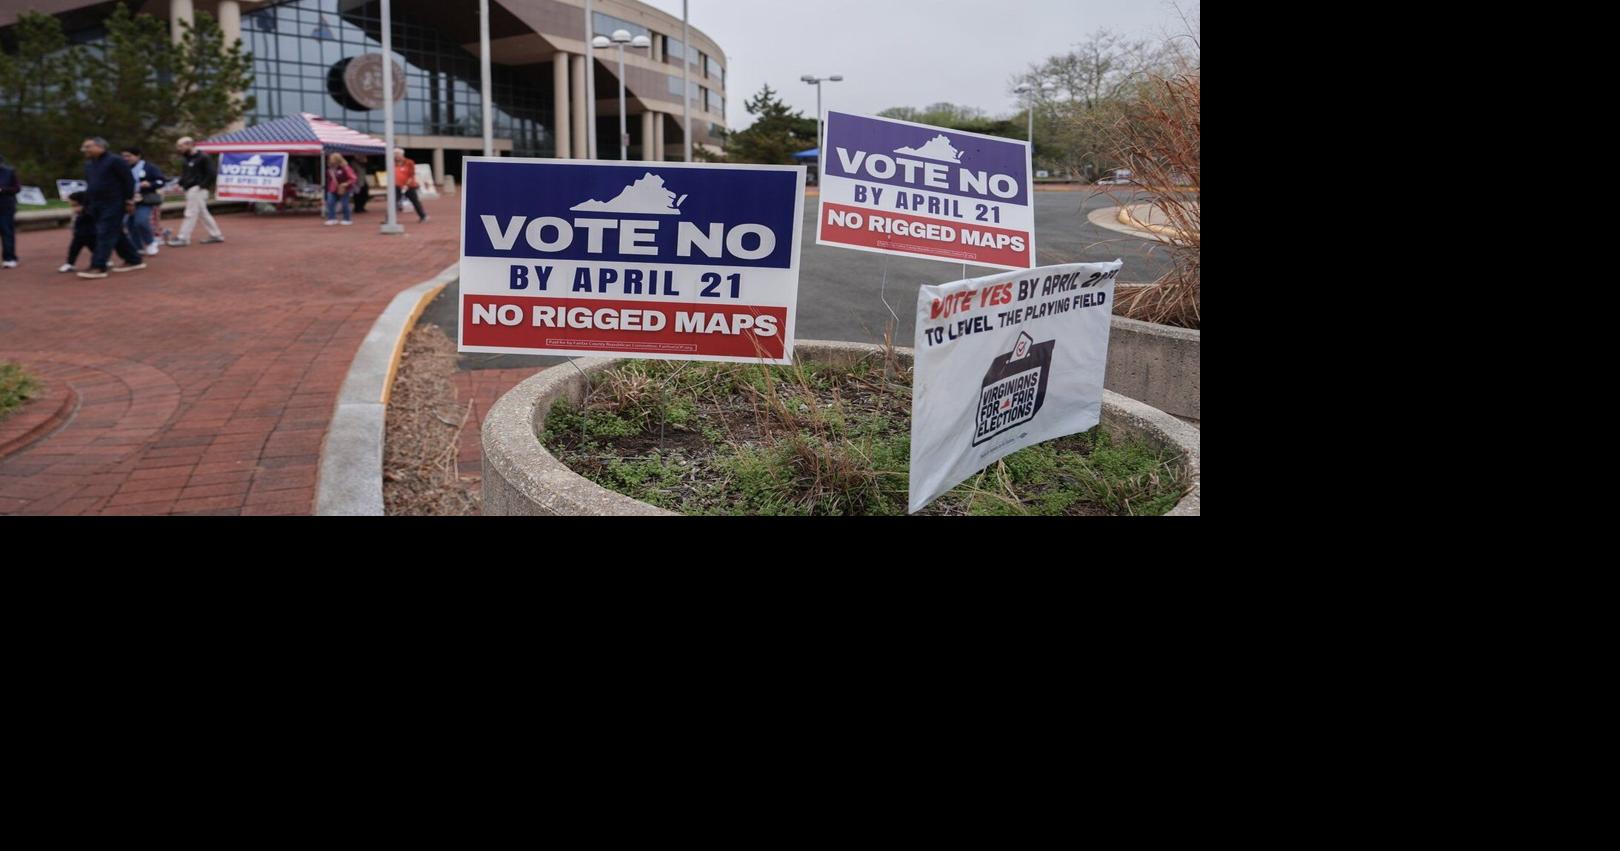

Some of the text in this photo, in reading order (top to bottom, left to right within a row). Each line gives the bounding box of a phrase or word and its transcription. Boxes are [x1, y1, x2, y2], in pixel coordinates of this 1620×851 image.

[221, 164, 281, 177] VOTE NO
[835, 146, 1019, 199] VOTE NO
[854, 184, 1000, 224] BY APRIL 21
[480, 214, 777, 260] VOTE NO
[827, 208, 864, 229] NO
[868, 217, 957, 243] RIGGED
[960, 228, 1025, 253] MAPS
[509, 264, 742, 299] BY APRIL 21
[930, 288, 978, 320] VOTE
[980, 281, 1013, 308] YES
[1017, 277, 1041, 302] BY
[1041, 271, 1081, 297] APRIL
[471, 303, 779, 338] NO RIGGED MAPS
[924, 291, 1106, 347] TO LEVEL THE PLAYING FIELD
[980, 387, 1035, 422] FOR FAIR
[983, 372, 1038, 406] VIRGINIANS
[977, 401, 1033, 438] ELECTIONS
